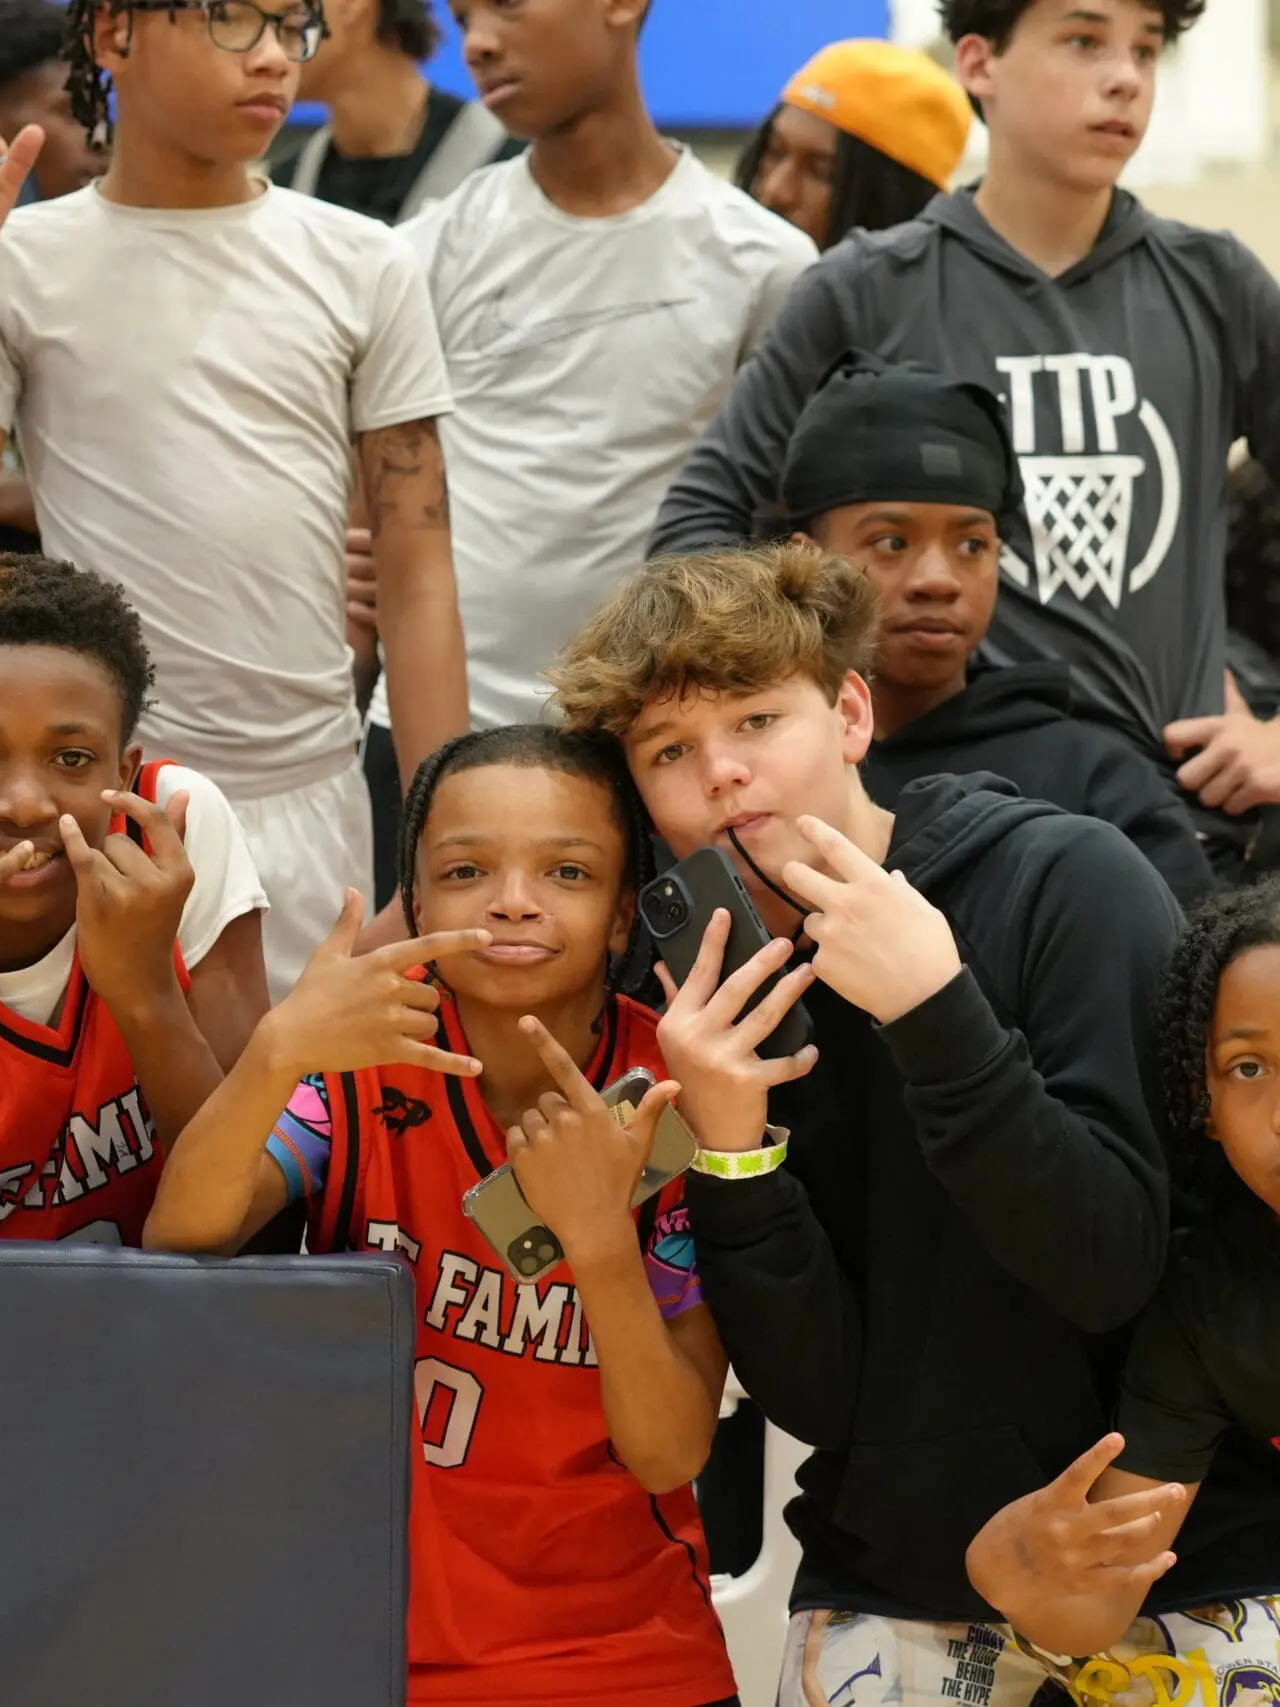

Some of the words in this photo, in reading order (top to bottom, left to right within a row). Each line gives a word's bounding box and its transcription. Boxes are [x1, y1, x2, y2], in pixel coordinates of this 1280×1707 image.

[995, 353, 1137, 454] TTP
[946, 1638, 969, 1661] THE
[955, 1660, 995, 1687] BEHIND
[1214, 1657, 1252, 1685] GOLDEN
[1256, 1658, 1279, 1674] STA
[941, 1676, 963, 1698] THE
[963, 1682, 992, 1706] HYPE
